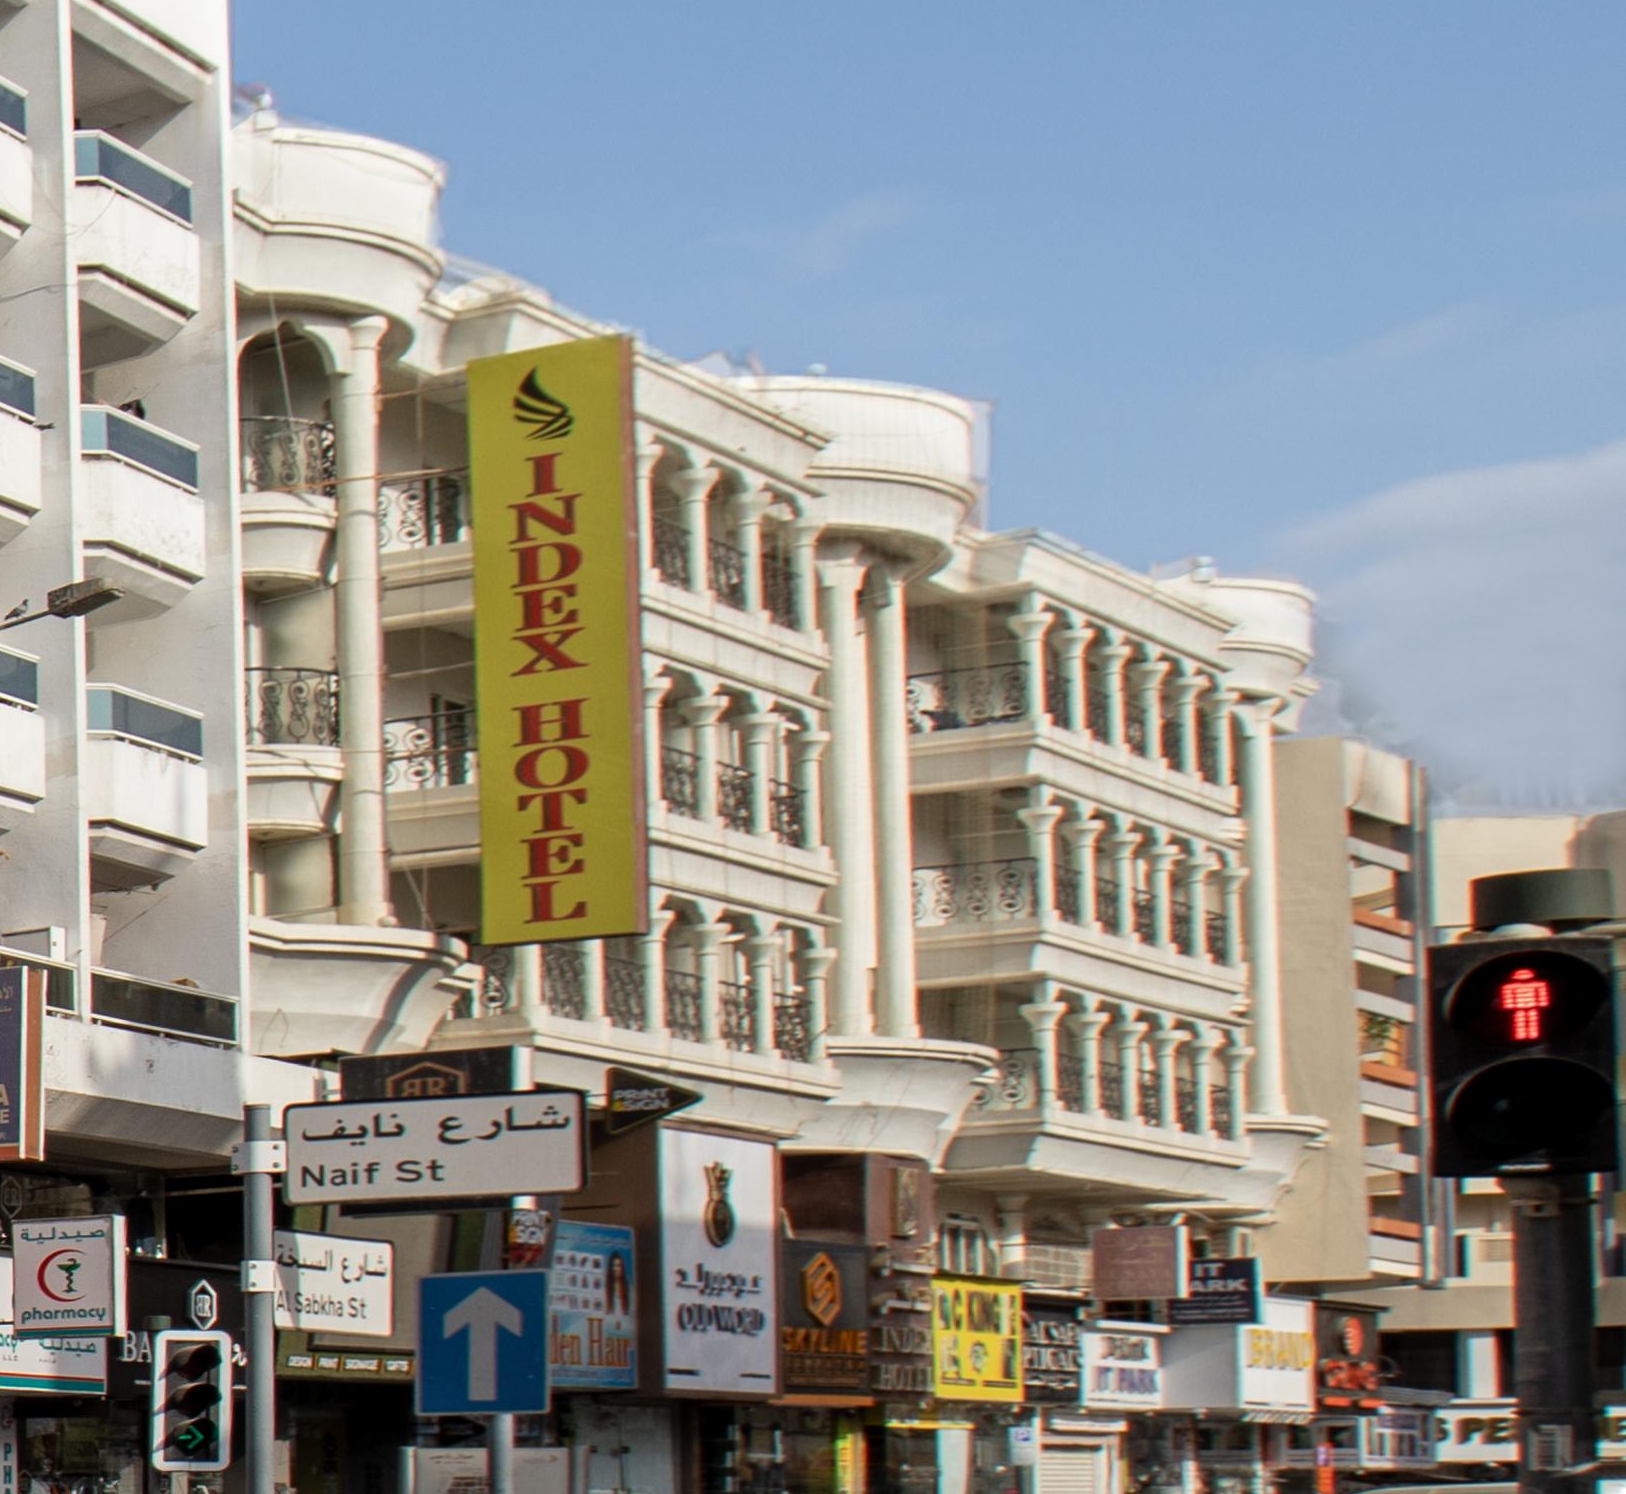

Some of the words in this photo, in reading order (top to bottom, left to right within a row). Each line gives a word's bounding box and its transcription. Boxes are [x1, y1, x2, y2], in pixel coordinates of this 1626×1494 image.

[507, 452, 589, 677] INDEX
[511, 698, 591, 924] HOTEL
[301, 1113, 406, 1147] نايف
[437, 1105, 570, 1145] شارع
[300, 1163, 380, 1187] Naif
[395, 1159, 445, 1183] St
[21, 1226, 106, 1243] صيدلية
[276, 1244, 334, 1276] السبخة
[340, 1252, 387, 1284] شارع
[1194, 1263, 1224, 1277] IT
[21, 1307, 106, 1323] pharmacy
[276, 1295, 291, 1312] Al
[295, 1292, 344, 1318] Sabkha
[347, 1297, 367, 1319] St
